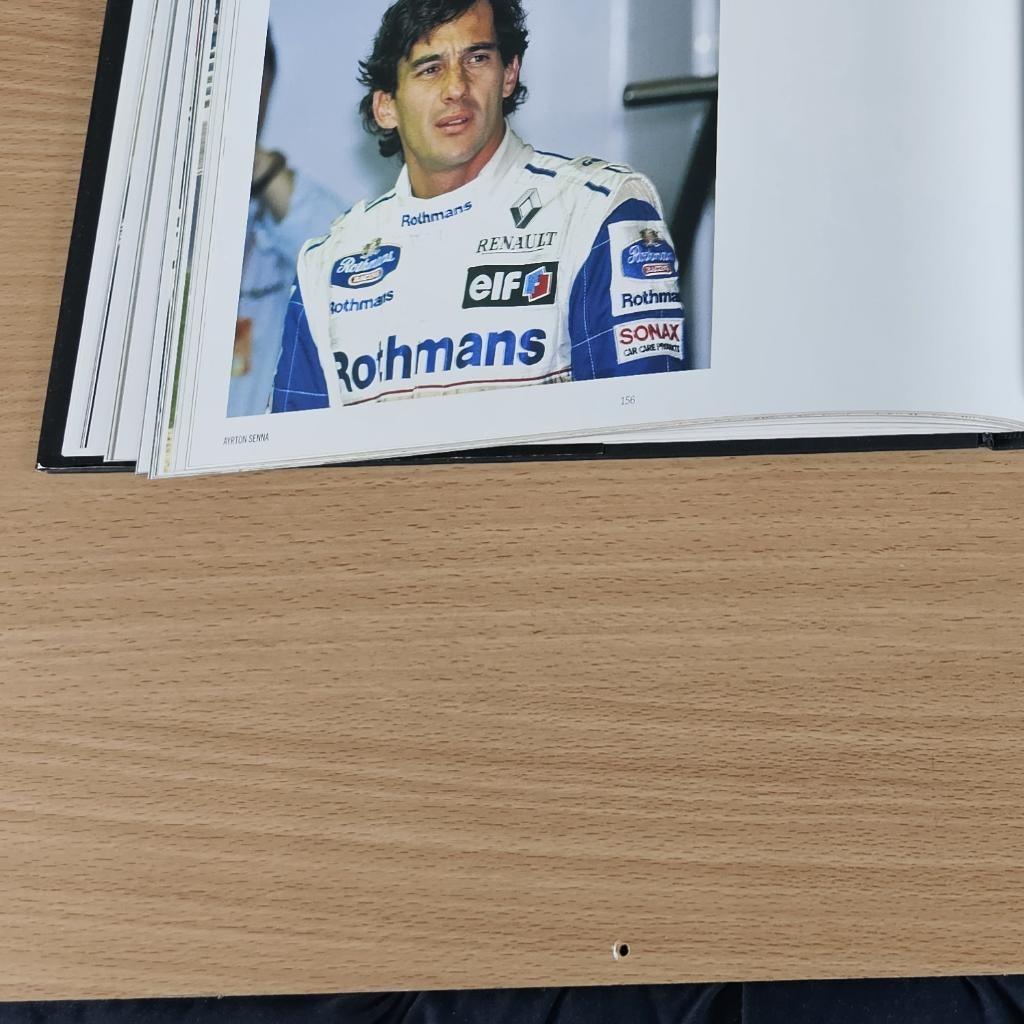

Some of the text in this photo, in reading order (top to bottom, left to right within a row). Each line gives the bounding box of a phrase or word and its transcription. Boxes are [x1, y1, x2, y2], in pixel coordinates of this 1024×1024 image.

[401, 200, 473, 227] Rothmans
[476, 231, 558, 254] RENAULT
[468, 271, 523, 302] elf
[621, 289, 680, 308] Rothma
[619, 323, 680, 345] SONAX
[332, 328, 547, 392] Rothmans
[620, 395, 636, 406] 156
[222, 433, 269, 446] AYRTON SENNA
